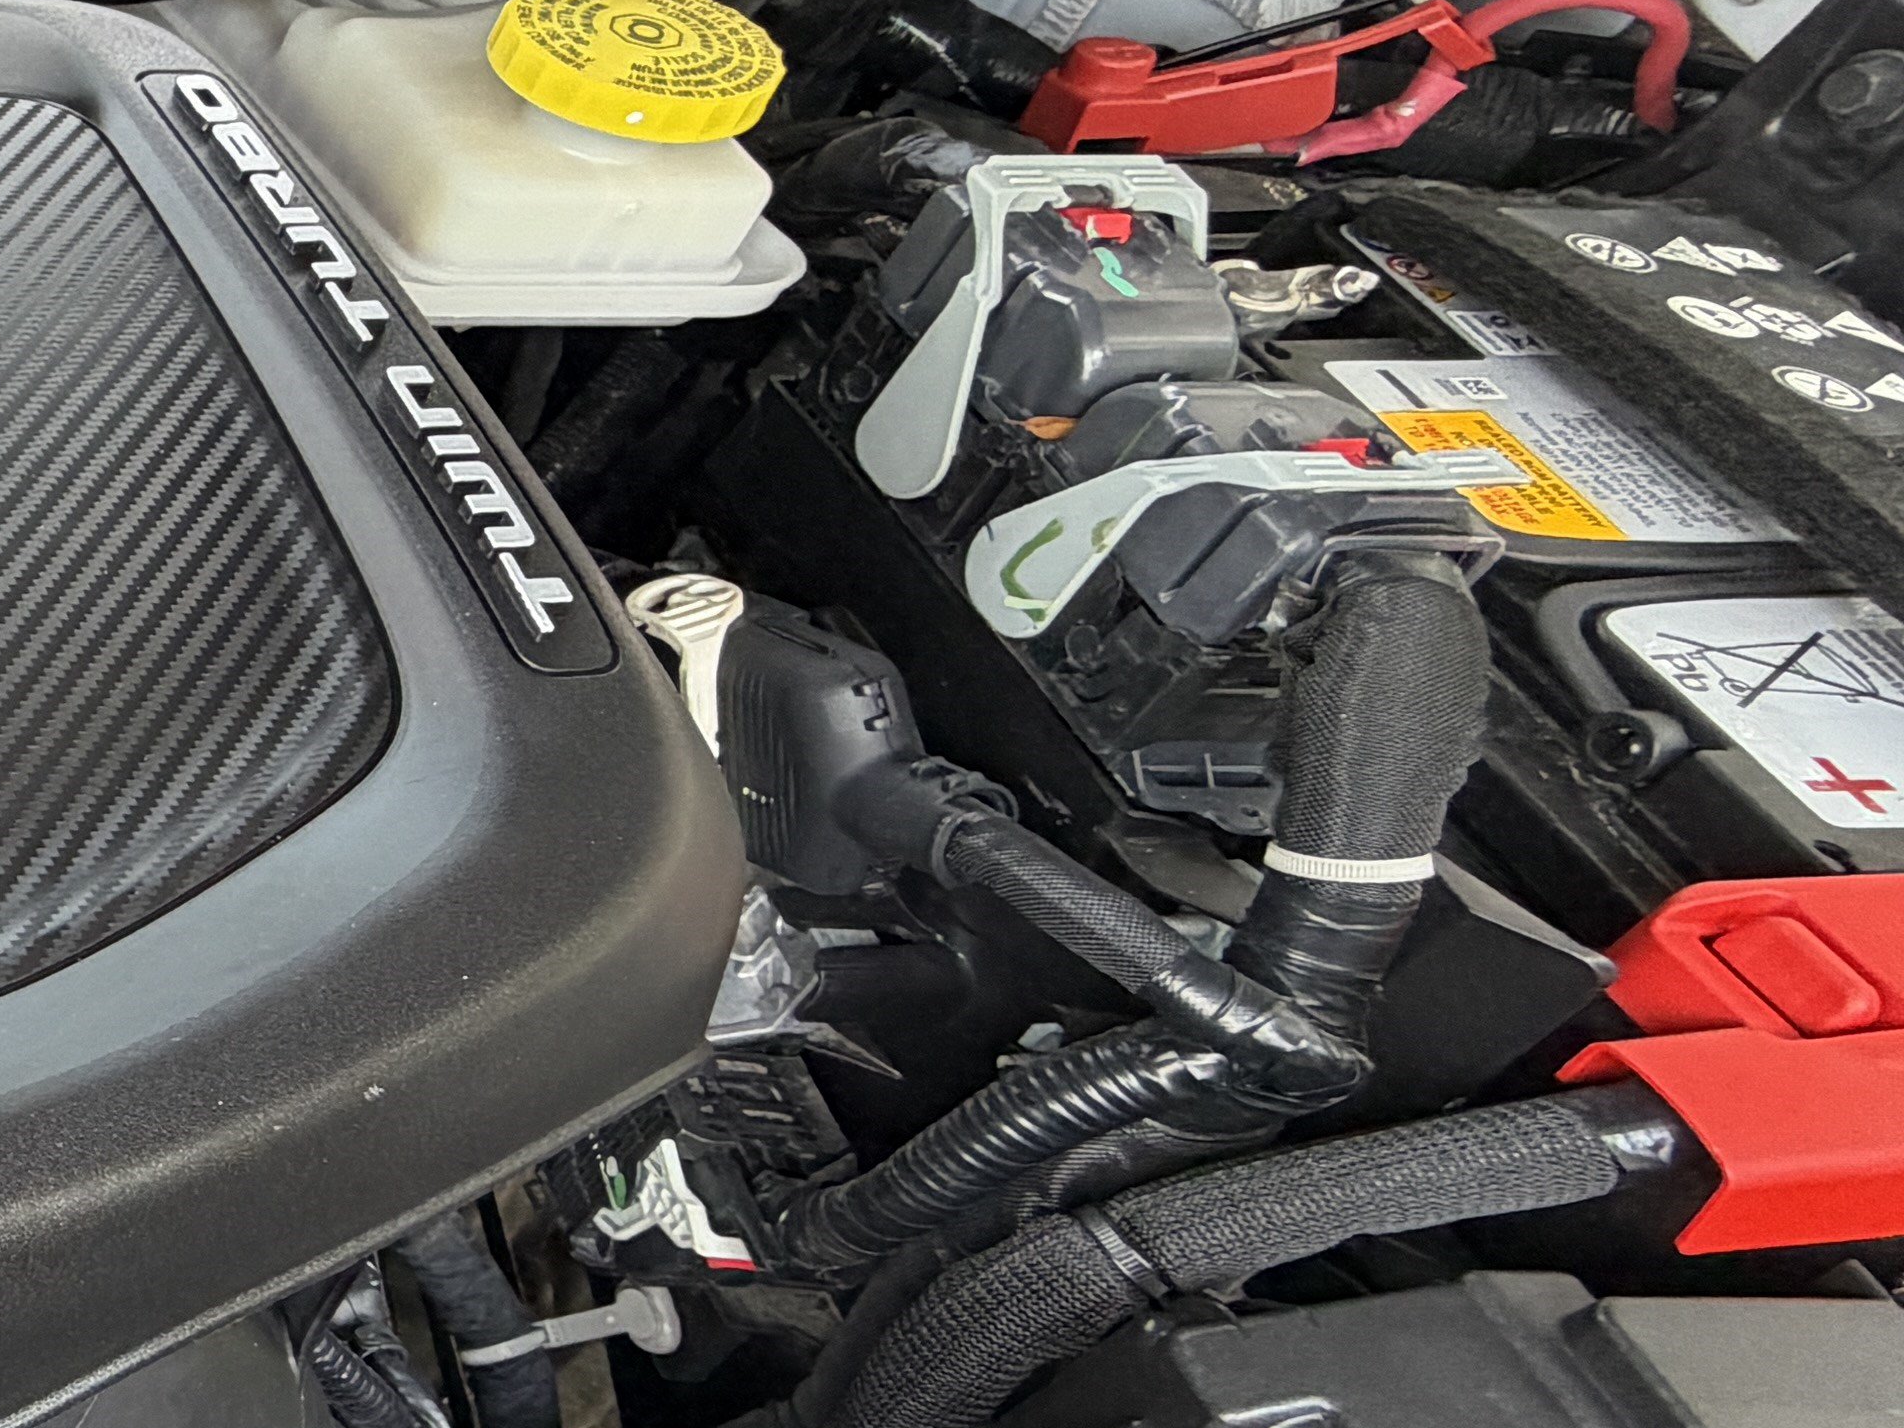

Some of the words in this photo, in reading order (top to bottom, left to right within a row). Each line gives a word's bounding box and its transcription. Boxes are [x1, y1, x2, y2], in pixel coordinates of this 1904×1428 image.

[628, 62, 666, 76] D'UN
[174, 74, 390, 349] TURBO
[388, 366, 574, 640] TWIN
[1471, 419, 1526, 456] SEALED
[1543, 483, 1607, 527] BATTERY
[1651, 652, 1709, 692] Pb
